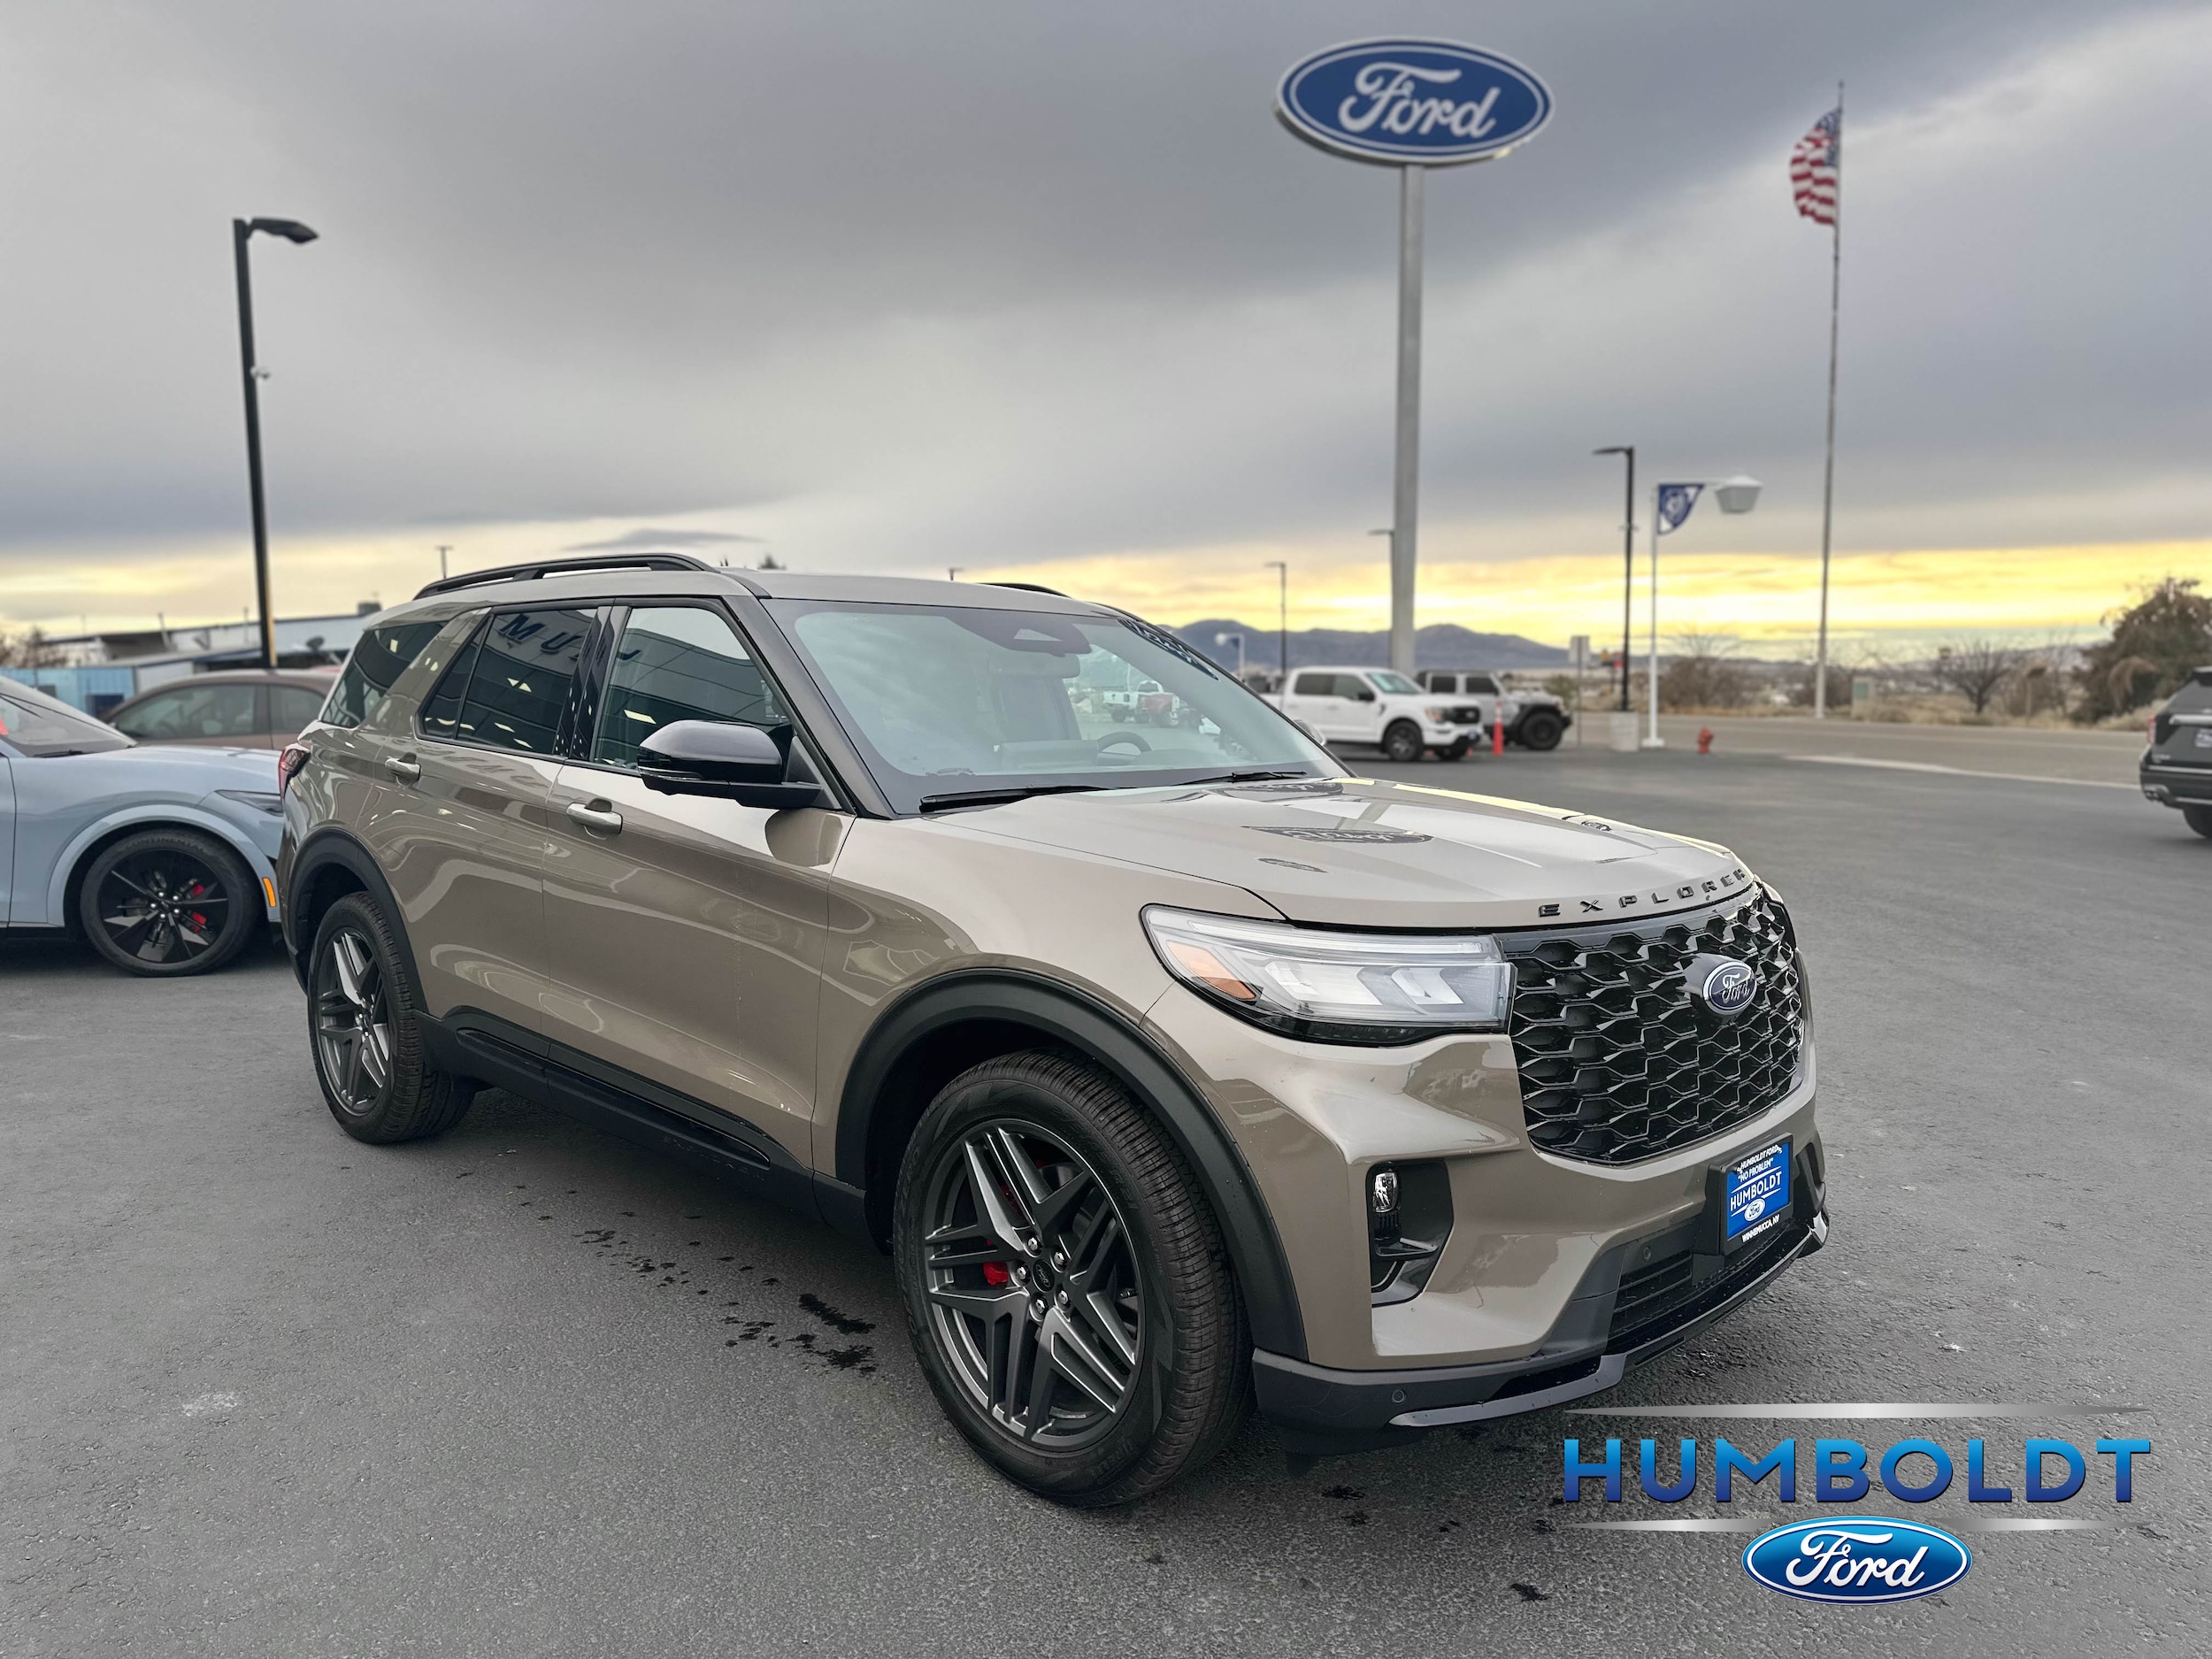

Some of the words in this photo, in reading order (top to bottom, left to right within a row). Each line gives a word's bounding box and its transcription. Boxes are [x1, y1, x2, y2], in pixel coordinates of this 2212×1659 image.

[1337, 61, 1502, 138] Ford
[1538, 868, 1747, 918] EXPLORER
[1722, 972, 1751, 1003] Ford
[1740, 1151, 1767, 1168] HUMBOLDT
[1730, 1171, 1782, 1211] HUMBOLDT
